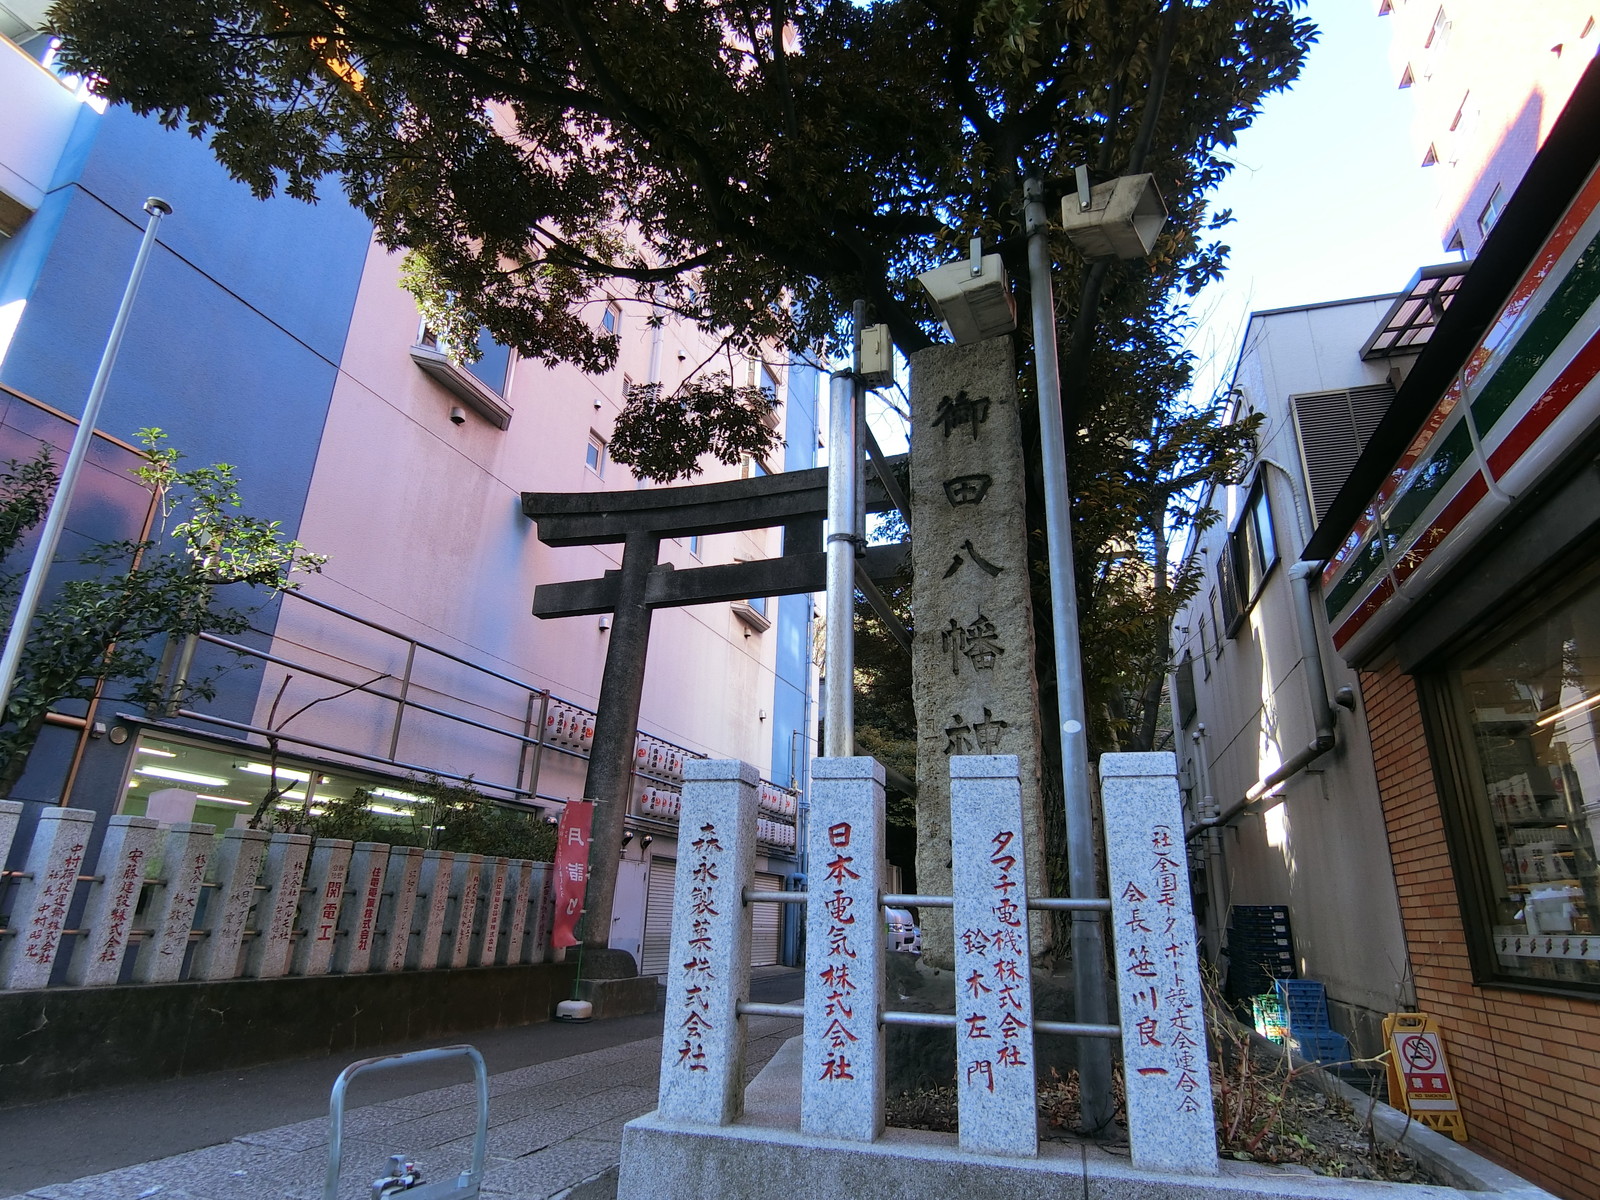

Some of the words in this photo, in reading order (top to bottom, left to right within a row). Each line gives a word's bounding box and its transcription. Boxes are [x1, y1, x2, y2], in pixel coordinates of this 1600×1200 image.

[931, 389, 1008, 868] 御田八幡神
[36, 843, 84, 964] 中村荷役運輸株式会社
[99, 848, 143, 962] 安藤建設株式会社
[317, 881, 342, 941] 関電工
[673, 821, 724, 1073] 森永製菓株式会社
[818, 821, 861, 1082] 日本電気株式会社
[989, 830, 1029, 1068] タマチ電機株式会社
[959, 928, 994, 1093] 鈴木左門
